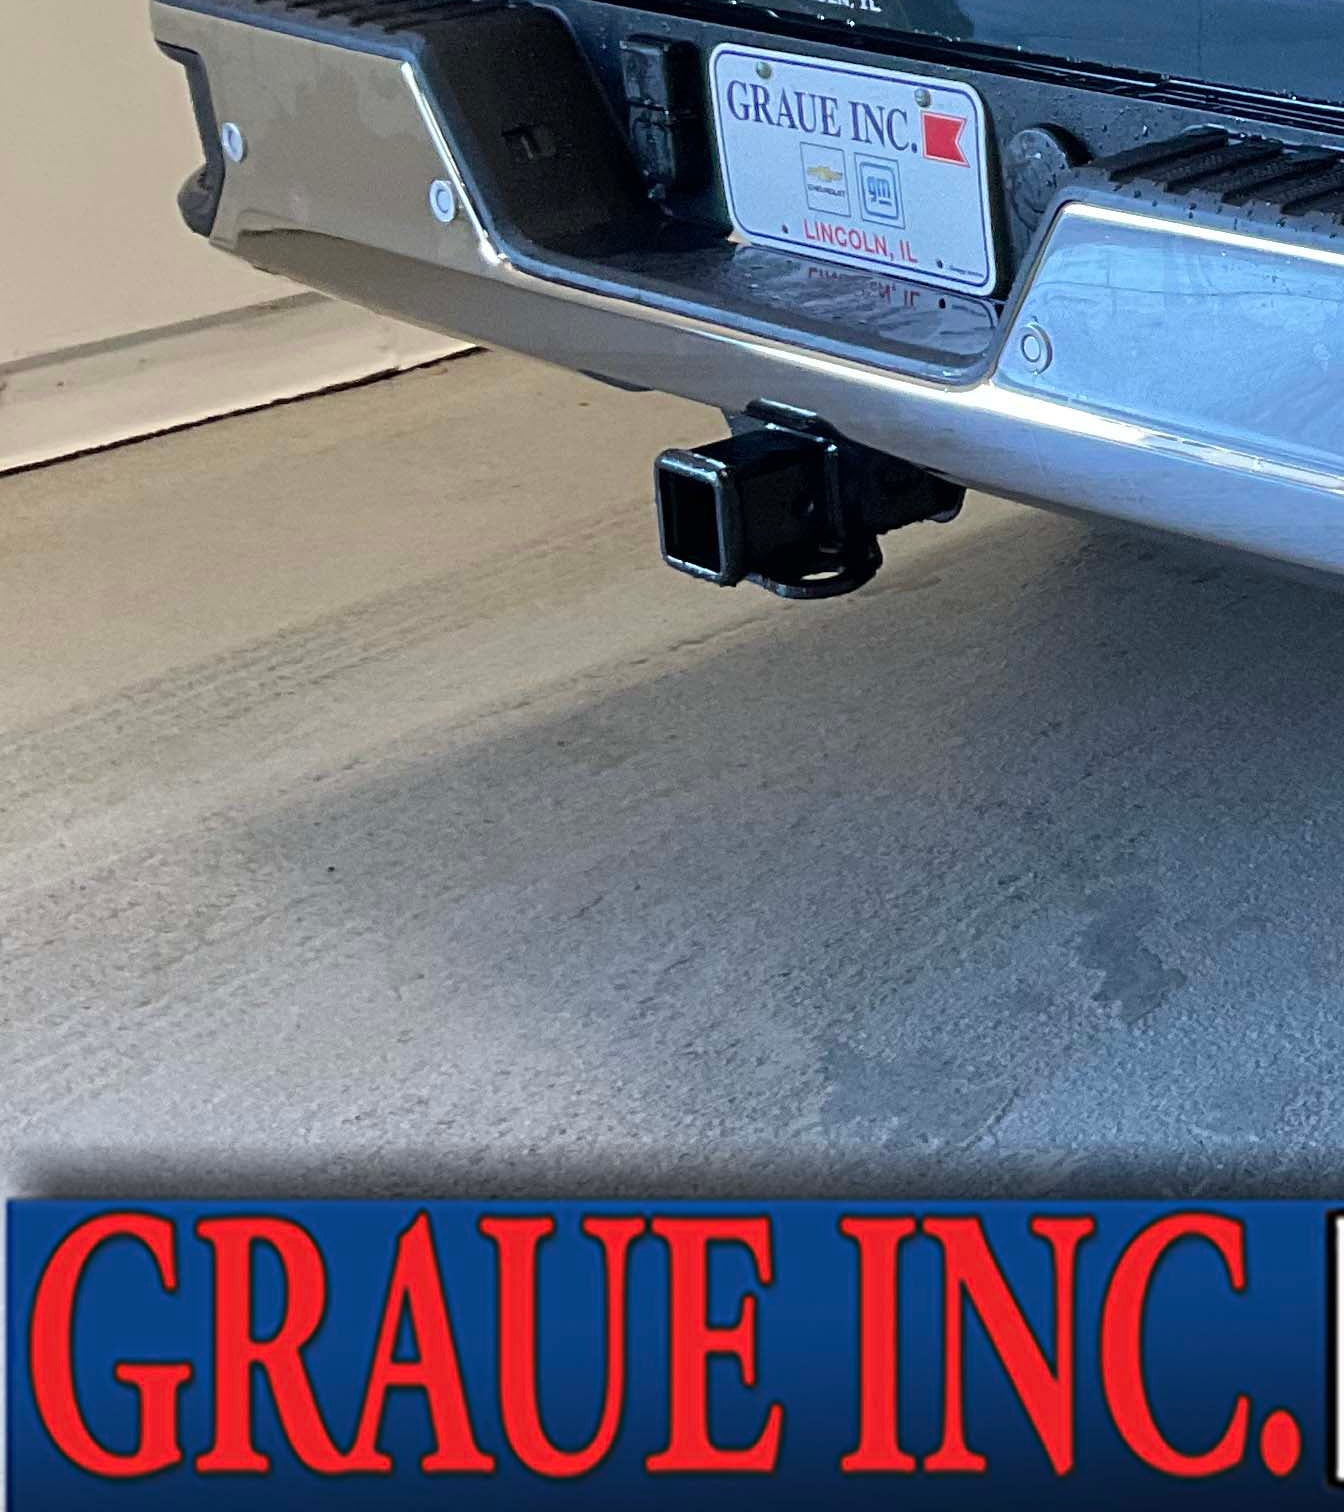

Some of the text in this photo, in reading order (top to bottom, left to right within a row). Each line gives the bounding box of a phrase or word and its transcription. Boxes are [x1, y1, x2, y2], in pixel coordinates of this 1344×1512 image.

[726, 78, 918, 154] GRAUE INC.
[802, 218, 919, 264] LINCOLN, IL
